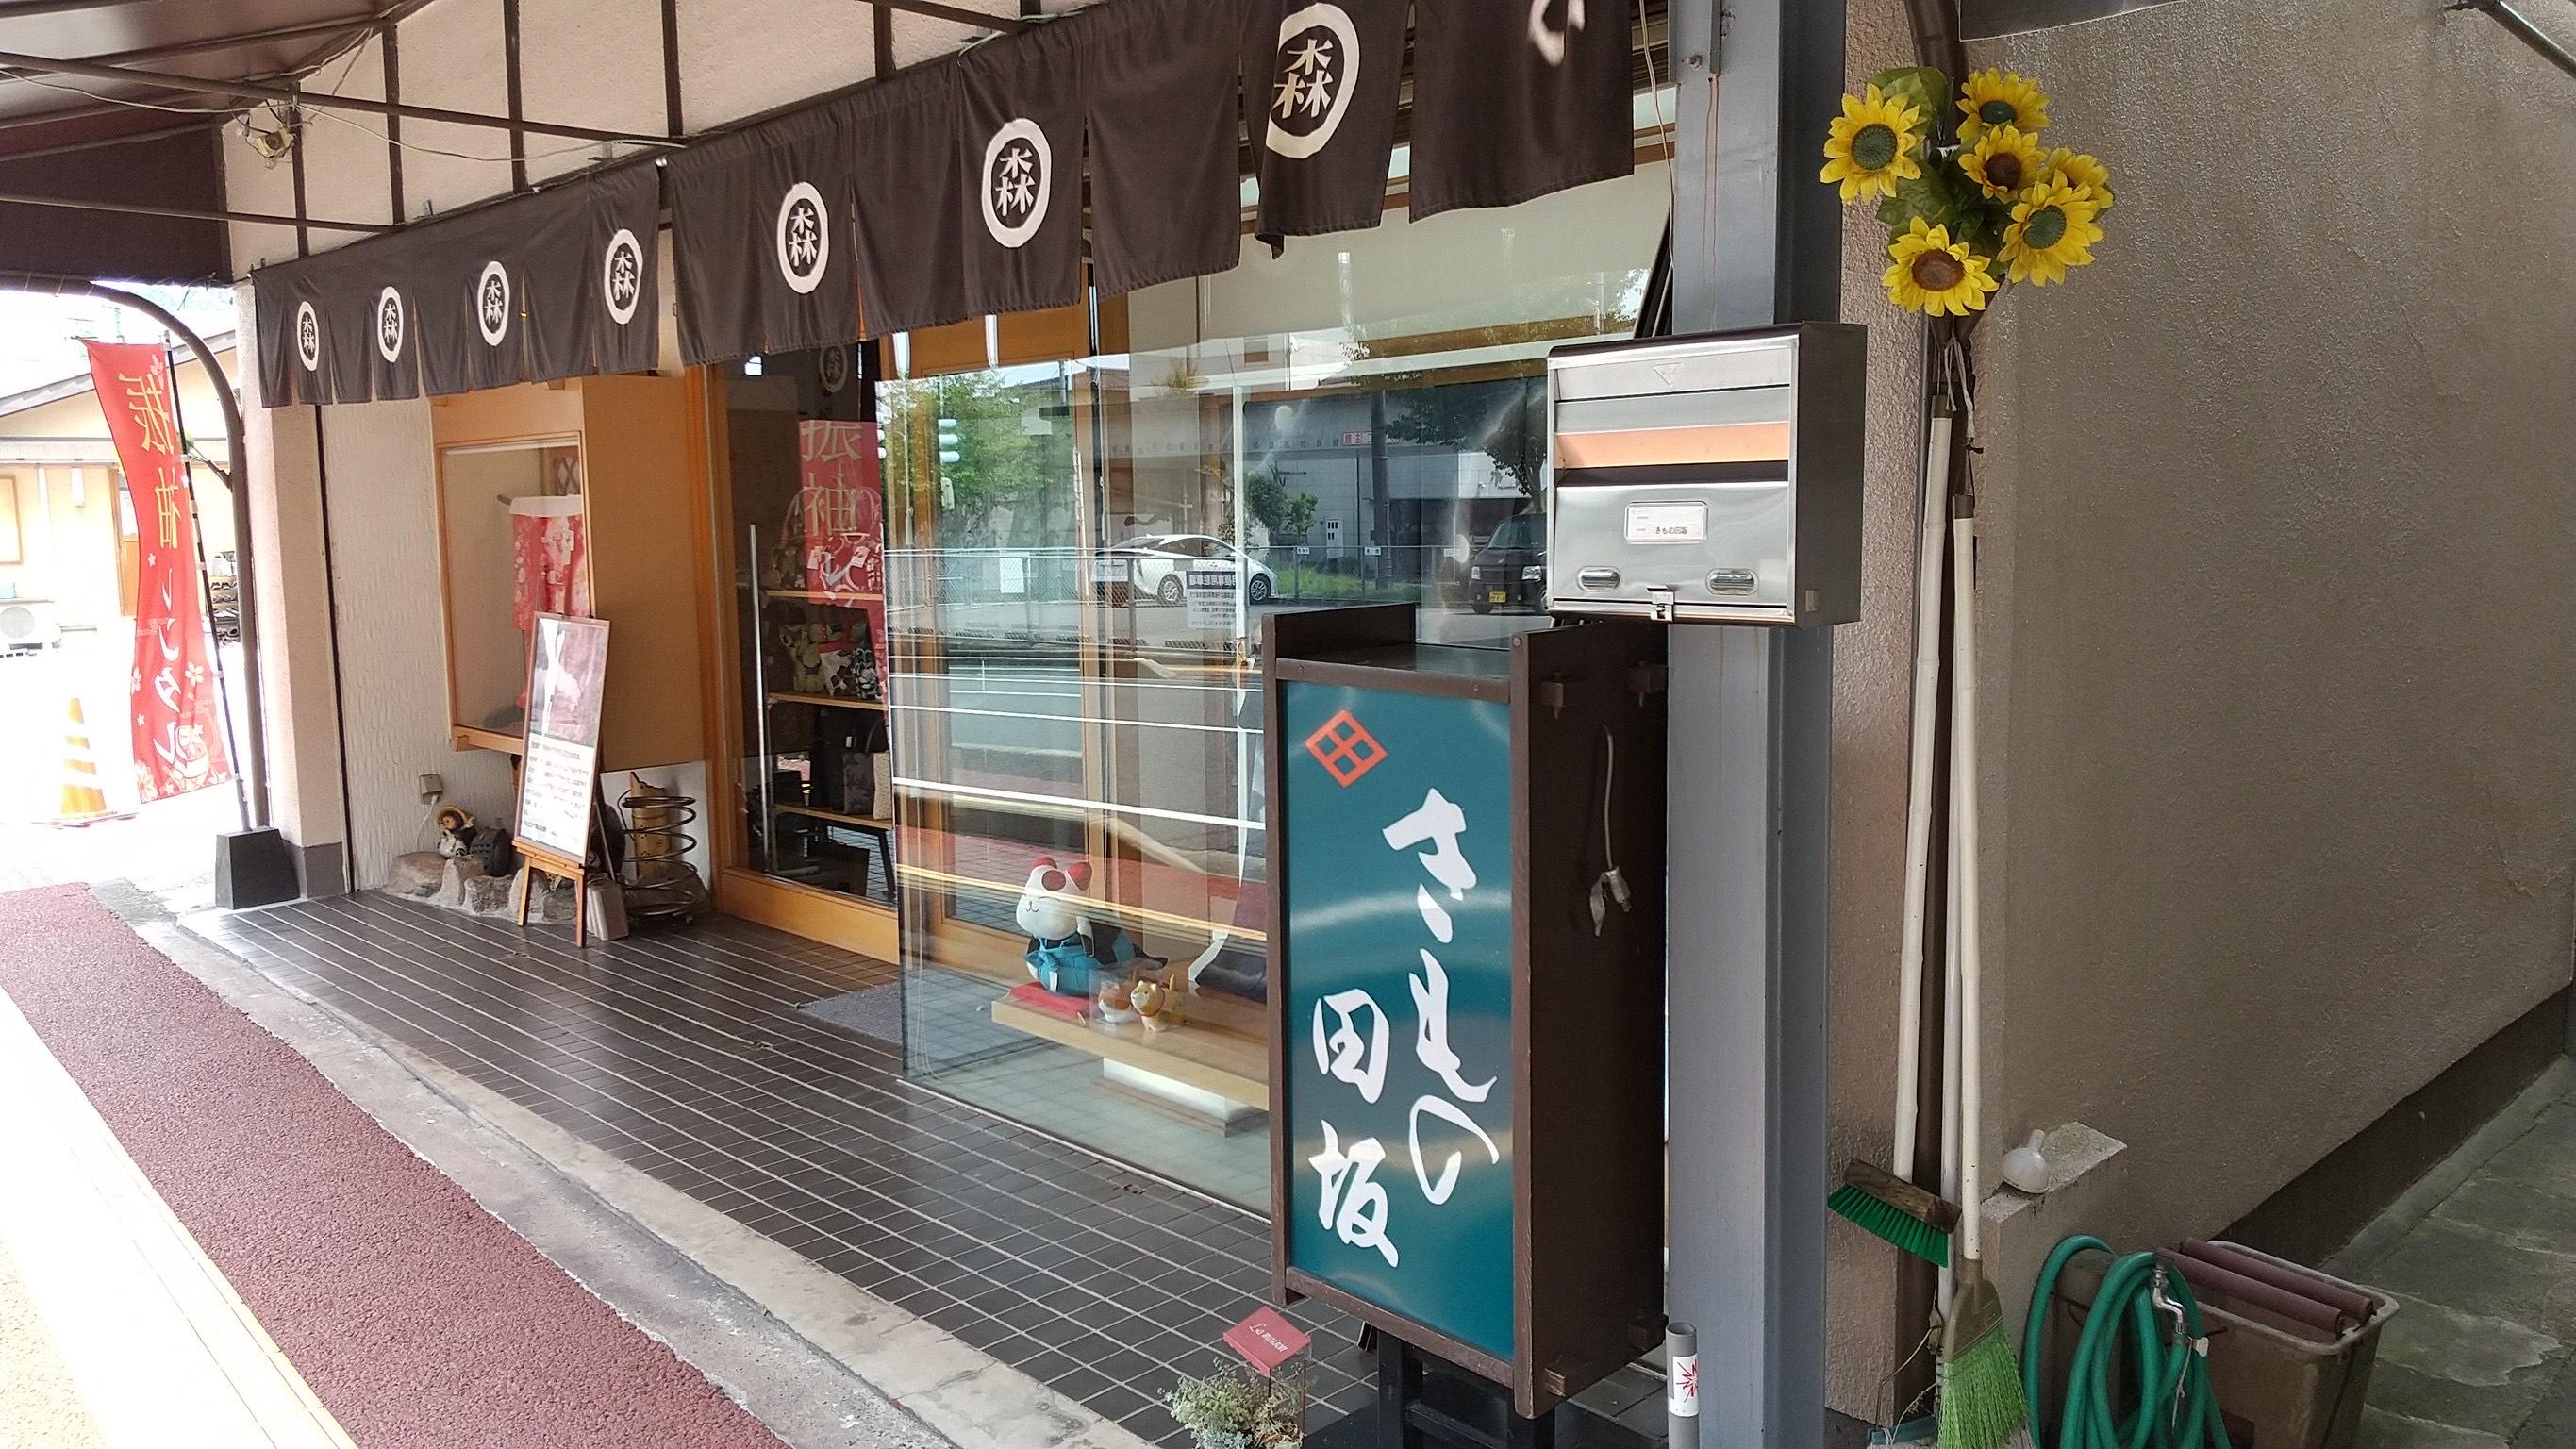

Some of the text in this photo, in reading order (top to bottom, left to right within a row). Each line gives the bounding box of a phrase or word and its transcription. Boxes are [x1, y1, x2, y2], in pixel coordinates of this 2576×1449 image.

[1273, 39, 1334, 119] 森
[995, 148, 1036, 217] 森
[788, 207, 818, 267] 森
[485, 280, 503, 325] 森
[613, 251, 636, 301] 森
[383, 303, 398, 343] 森
[1383, 788, 1500, 1205] きもの
[1308, 988, 1398, 1268] 田坂
